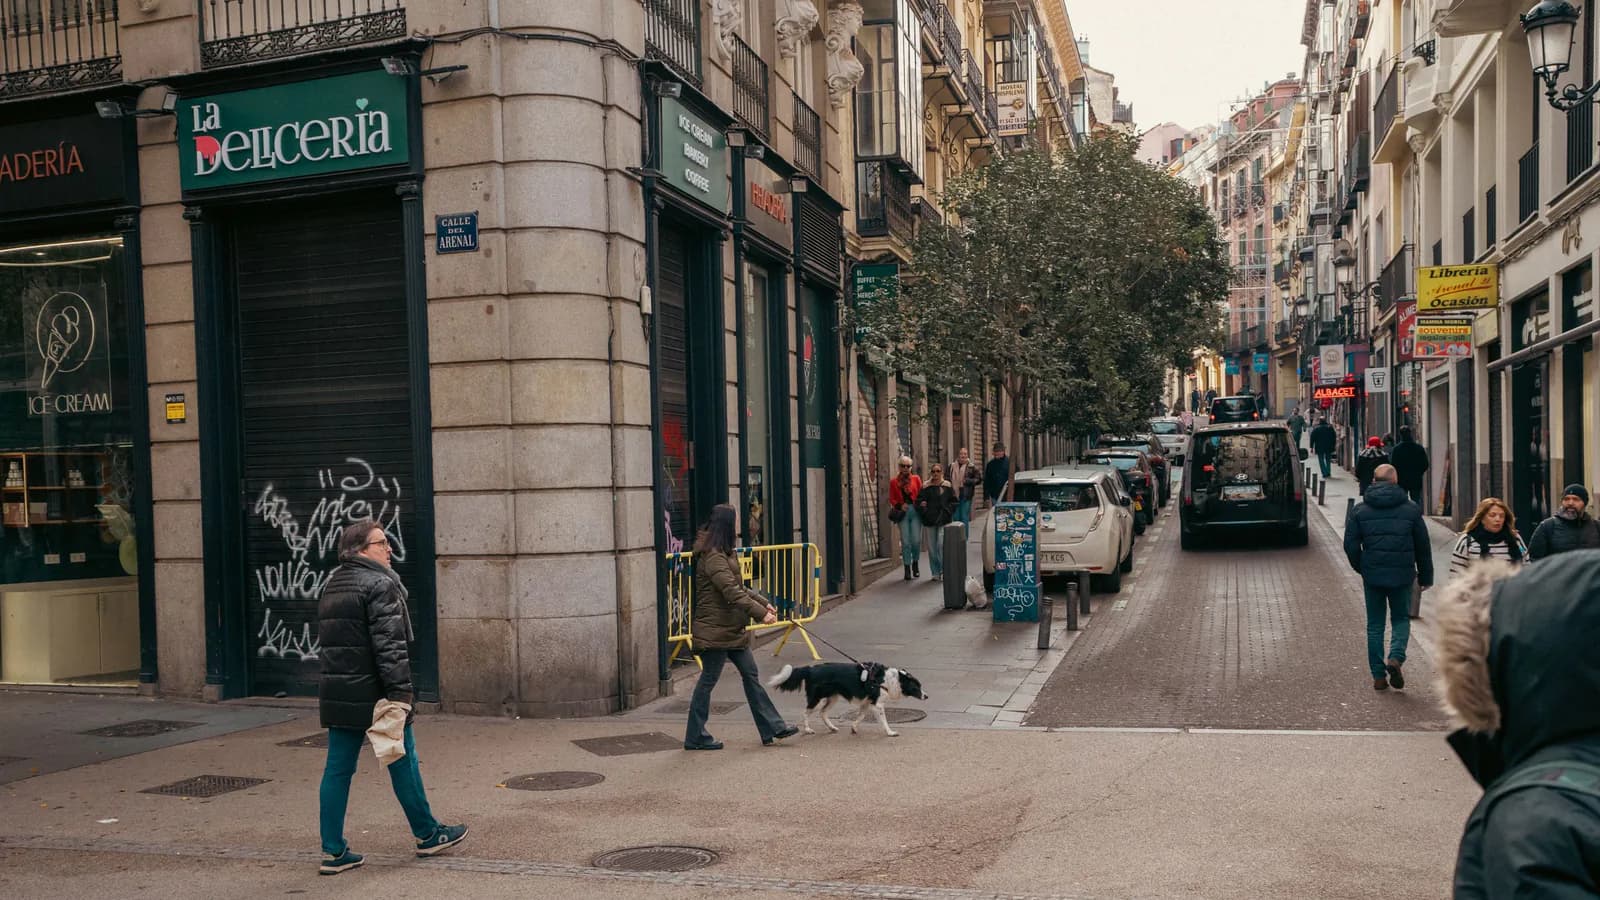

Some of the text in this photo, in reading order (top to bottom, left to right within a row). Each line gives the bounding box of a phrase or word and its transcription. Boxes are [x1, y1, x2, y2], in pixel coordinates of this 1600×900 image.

[678, 114, 712, 148] ICE CREAM
[0, 140, 84, 183] ADERÍA
[683, 142, 709, 169] BAKERY
[684, 168, 710, 193] COFFEE
[441, 217, 471, 227] CALLE
[439, 234, 475, 249] ARENAL
[29, 393, 110, 415] ICE CREAM
